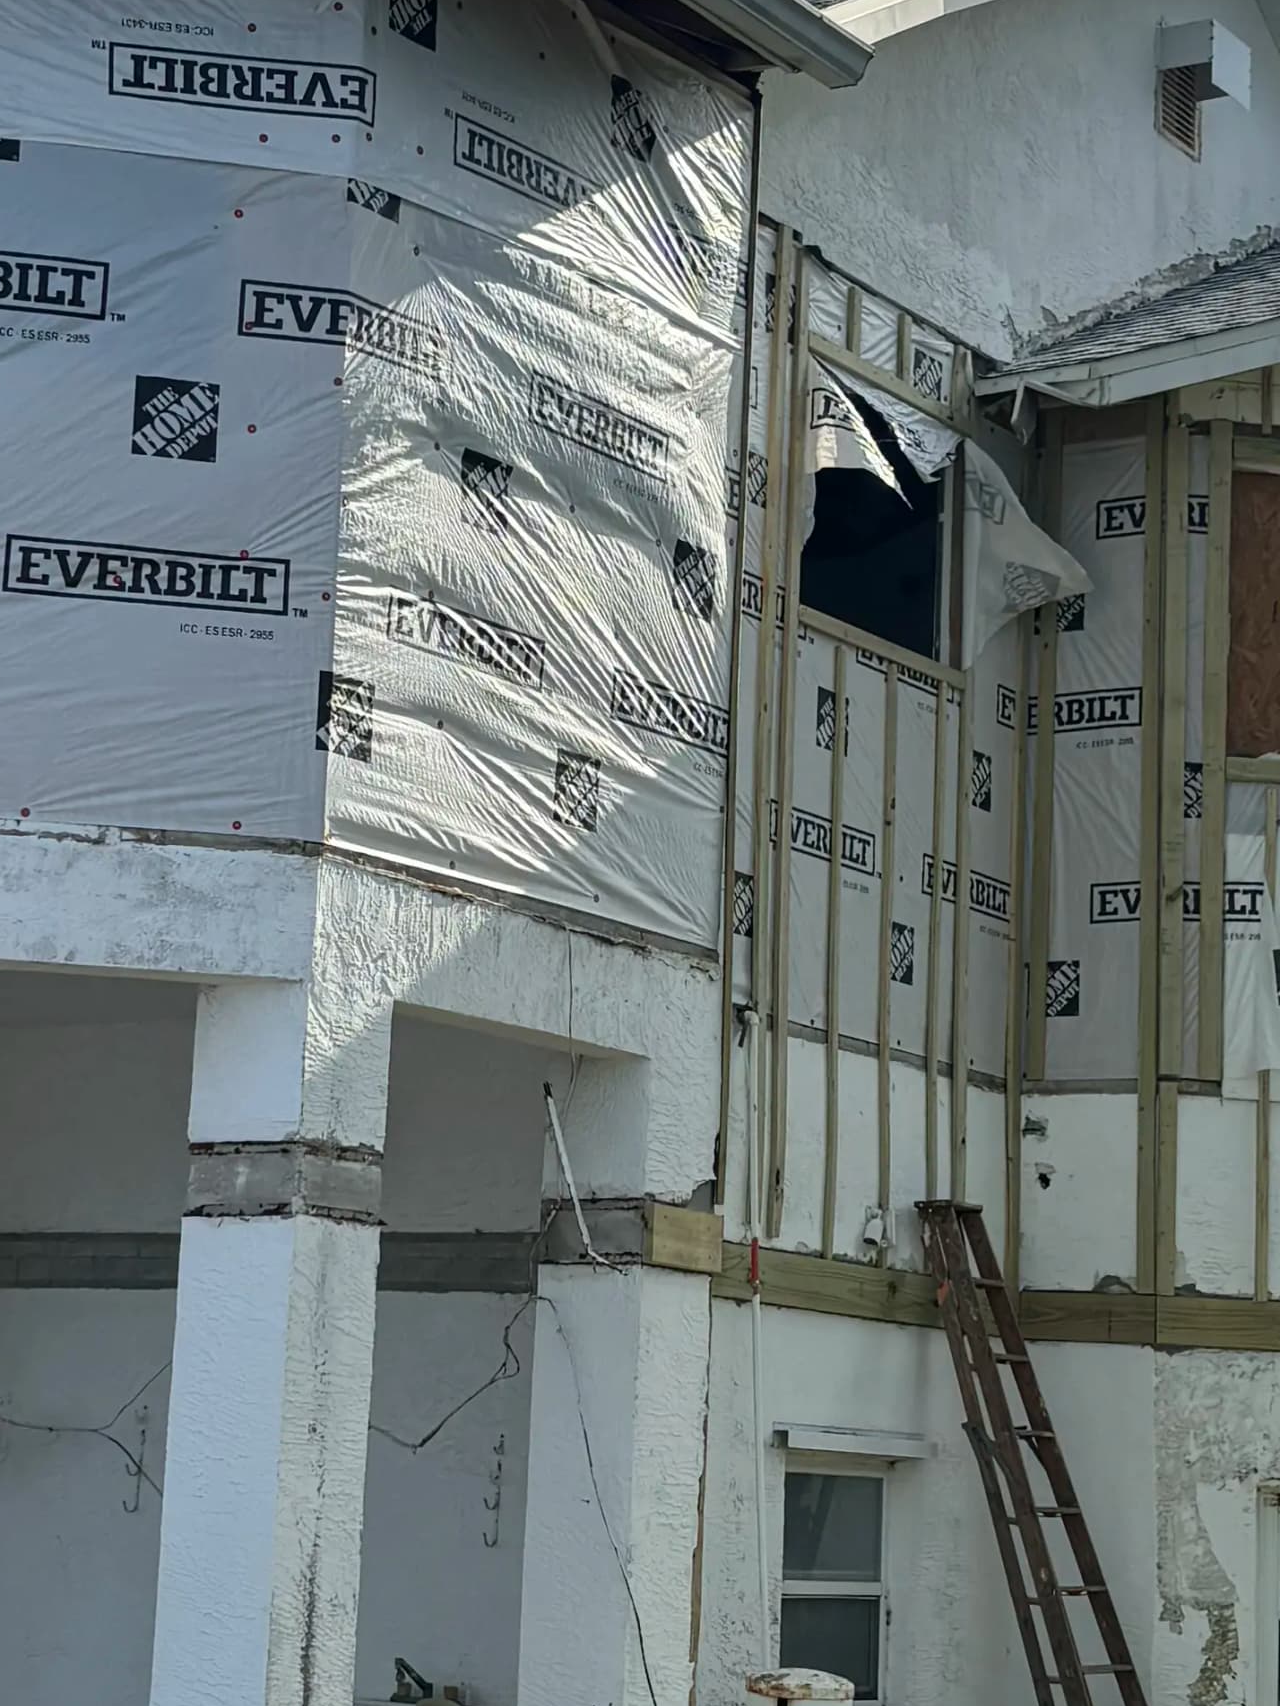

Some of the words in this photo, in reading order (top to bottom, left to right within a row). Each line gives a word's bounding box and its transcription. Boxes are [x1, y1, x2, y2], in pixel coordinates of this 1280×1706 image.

[122, 54, 368, 113] EVERBILT
[110, 312, 126, 322] TM
[133, 382, 219, 456] HOME
[142, 386, 180, 417] THE
[165, 412, 218, 458] DEPOT
[16, 546, 277, 604] EVERBILT
[292, 608, 308, 618] TM
